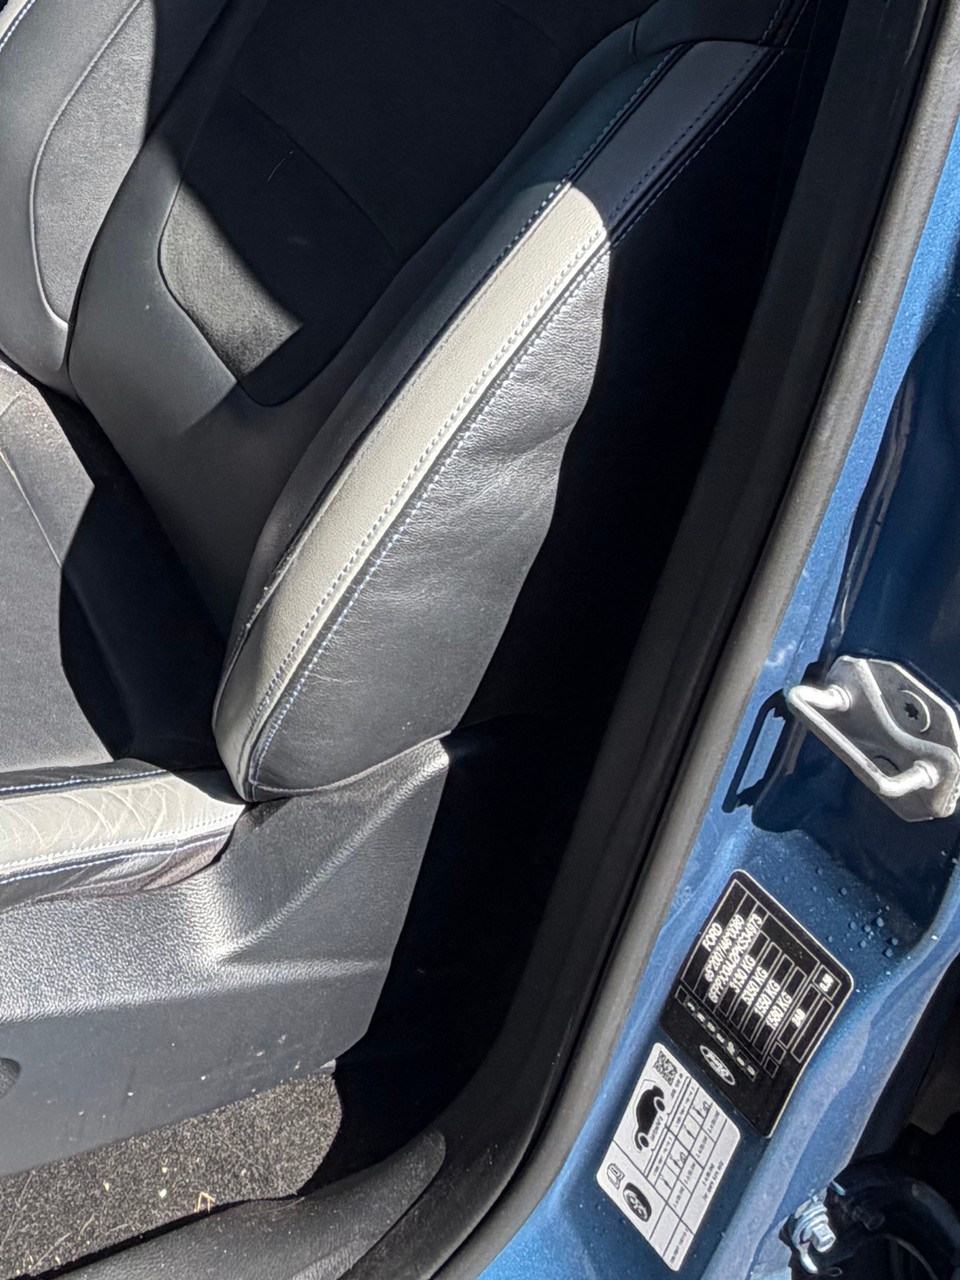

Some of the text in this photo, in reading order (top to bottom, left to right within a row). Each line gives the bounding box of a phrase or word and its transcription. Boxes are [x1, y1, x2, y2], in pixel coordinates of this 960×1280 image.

[702, 922, 722, 952] FORD
[741, 954, 756, 973] KG
[741, 966, 768, 1005] 5350 KG
[753, 980, 780, 1018] 1550 KG
[777, 992, 792, 1009] KG
